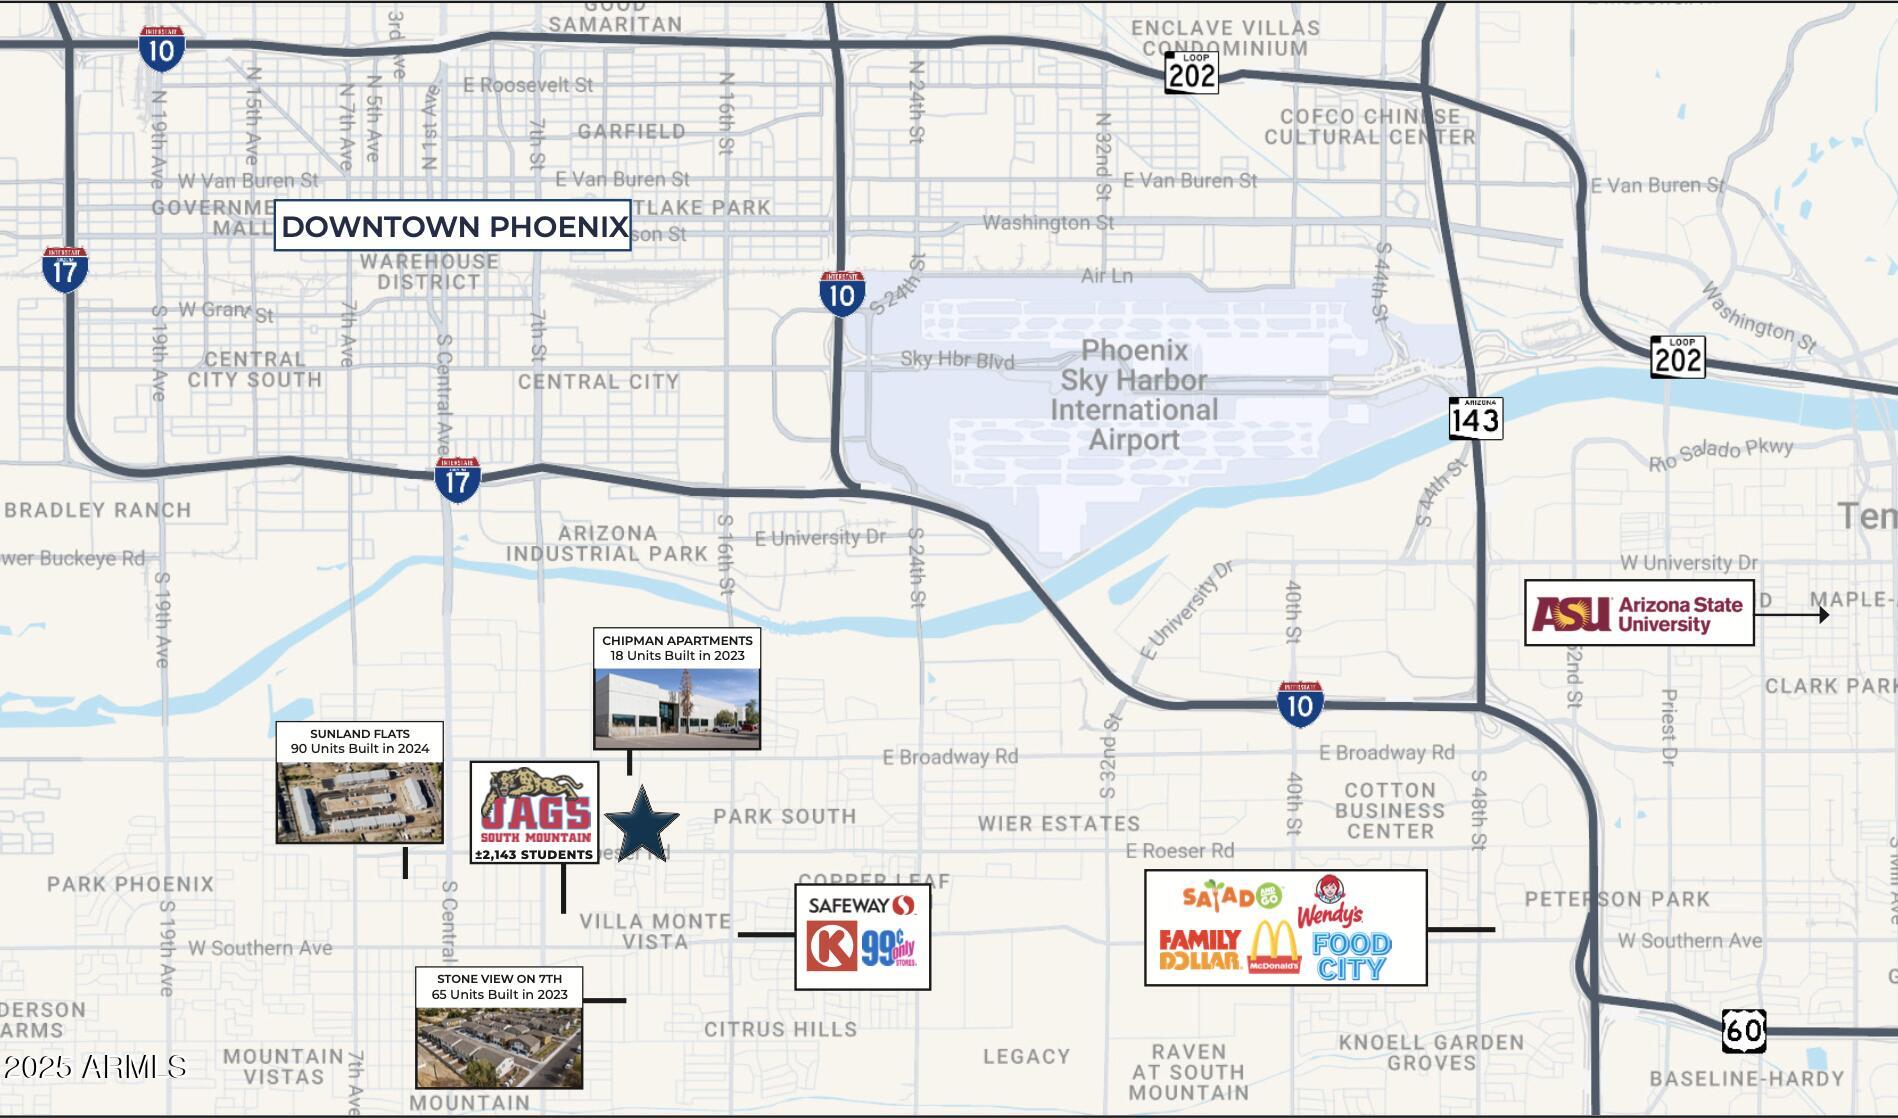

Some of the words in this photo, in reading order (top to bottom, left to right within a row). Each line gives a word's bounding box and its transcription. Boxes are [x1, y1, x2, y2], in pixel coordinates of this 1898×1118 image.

[549, 16, 683, 33] SAMARITAN
[1133, 20, 1232, 35] ENCLAVE
[1243, 20, 1319, 35] VILLAS
[149, 40, 175, 62] 10
[1143, 40, 1308, 57] CONDOMINIUM
[1183, 54, 1210, 62] LOOP
[1169, 63, 1216, 88] 202
[464, 77, 473, 92] E
[481, 77, 568, 92] Roosevelt
[576, 78, 592, 92] St
[152, 91, 166, 103] N
[152, 112, 167, 149] 19th
[578, 124, 685, 139] GARFIELD
[150, 156, 166, 189] Ave
[179, 174, 195, 188] W
[202, 174, 235, 188] Van
[243, 173, 294, 188] Buren
[301, 173, 317, 187] St
[1592, 178, 1601, 193] E
[1608, 179, 1641, 192] Van
[1649, 178, 1700, 192] Buren
[1708, 177, 1724, 193] St
[213, 220, 273, 236] MALL
[283, 216, 479, 237] DOWNTOWN
[490, 215, 629, 238] PHOENIX
[984, 215, 1090, 233] Washington
[1097, 215, 1113, 230] St
[360, 254, 499, 270] WAREHOUSE
[54, 262, 77, 283] 17
[1082, 268, 1105, 282] Air
[1112, 269, 1132, 283] Ln
[379, 274, 480, 289] DISTRICT
[830, 285, 855, 307] 10
[437, 335, 452, 345] S
[1082, 338, 1187, 361] Phoenix
[205, 351, 305, 367] CENTRAL
[1656, 349, 1702, 373] 202
[188, 372, 237, 387] CITY
[248, 372, 320, 387] SOUTH
[437, 352, 453, 414] Central
[519, 374, 619, 389] CENTRAL
[630, 374, 678, 389] CITY
[1062, 368, 1108, 396] Sky
[1118, 368, 1207, 391] Harbor
[1053, 395, 1217, 420] International
[1453, 409, 1499, 432] 143
[438, 417, 450, 455] Ave
[1089, 428, 1179, 456] Airport
[1650, 457, 1676, 471] Rio
[1680, 439, 1740, 461] Salado
[1746, 438, 1793, 457] Pkwy
[446, 472, 470, 493] 17
[6, 503, 104, 517] BRADLEY
[116, 503, 189, 517] RANCH
[559, 526, 656, 540] ARIZONA
[756, 531, 765, 546] E
[772, 531, 860, 548] University
[867, 529, 885, 543] Dr
[508, 546, 639, 561] INDUSTRIAL
[650, 546, 706, 561] PARK
[1619, 597, 1690, 612] Arizona
[1694, 597, 1743, 612] State
[1532, 597, 1612, 632] ASU
[1619, 616, 1711, 635] University
[603, 636, 663, 645] CHIPMAN
[667, 636, 753, 645] APARTMENTS
[611, 651, 623, 660] 18
[628, 650, 661, 660] Units
[665, 650, 695, 660] Built
[699, 650, 710, 660] in
[714, 651, 745, 660] 2023
[1288, 695, 1314, 717] 10
[1662, 690, 1677, 740] Priest
[311, 730, 370, 738] SUNLAND
[374, 730, 410, 738] FLATS
[291, 744, 307, 753] 90
[312, 743, 345, 753] Units
[349, 743, 379, 753] Built
[383, 743, 394, 753] in
[398, 744, 430, 753] 2024
[1321, 745, 1329, 760] E
[1337, 745, 1425, 763] Broadway
[1433, 745, 1454, 759] Rd
[1663, 748, 1678, 766] Dr
[1287, 772, 1302, 811] 40th
[1346, 783, 1434, 797] COTTON
[481, 796, 592, 830] JAGS
[715, 809, 771, 824] PARK
[783, 809, 855, 824] SOUTH
[1337, 803, 1444, 818] BUSINESS
[979, 816, 1031, 831] WIER
[1043, 816, 1139, 831] ESTATES
[1287, 819, 1302, 835] St
[1348, 824, 1433, 838] CENTER
[481, 833, 520, 842] SOUTH
[525, 833, 592, 842] MOUNTAIN
[521, 850, 593, 859] STUDENTS
[48, 877, 104, 891] PARK
[116, 877, 212, 891] PHOENIX
[1183, 879, 1255, 912] SALAD
[161, 901, 175, 911] S
[809, 898, 890, 913] SAFEWAY
[580, 914, 642, 928] VILLA
[653, 914, 730, 928] MONTE
[1298, 902, 1363, 928] Wendy's
[161, 920, 176, 957] 19th
[623, 934, 687, 949] VISTA
[1160, 930, 1241, 950] FAMILY
[1312, 932, 1392, 956] FOOD
[189, 941, 205, 955] W
[213, 940, 292, 955] Southern
[300, 941, 332, 955] Ave
[893, 940, 915, 960] only
[1160, 952, 1239, 970] DOLLAR
[1250, 962, 1299, 970] McDonald's
[1317, 957, 1387, 980] CITY
[161, 964, 175, 996] Ave
[437, 974, 478, 984] STONE
[481, 974, 514, 984] VIEW
[516, 974, 536, 984] ON
[539, 974, 562, 984] 7TH
[432, 990, 446, 999] 65
[451, 989, 484, 999] Units
[489, 989, 518, 999] Built
[523, 989, 533, 999] in
[538, 990, 568, 999] 2023
[705, 1022, 784, 1037] CITRUS
[795, 1022, 856, 1036] HILLS
[1726, 1018, 1763, 1043] 60
[1340, 1035, 1424, 1050] KNOELL
[1435, 1035, 1523, 1050] GARDEN
[224, 1049, 342, 1064] MOUNTAIN
[985, 1049, 1069, 1064] LEGACY
[1153, 1044, 1224, 1059] RAVEN
[1388, 1056, 1475, 1070] GROVES
[244, 1069, 323, 1084] VISTAS
[1133, 1065, 1160, 1079] AT
[1171, 1065, 1243, 1080] SOUTH
[1651, 1071, 1843, 1086] BASELINE-HARDY
[1130, 1085, 1247, 1100] MOUNTAIN
[410, 1096, 528, 1110] MOUNTAIN
